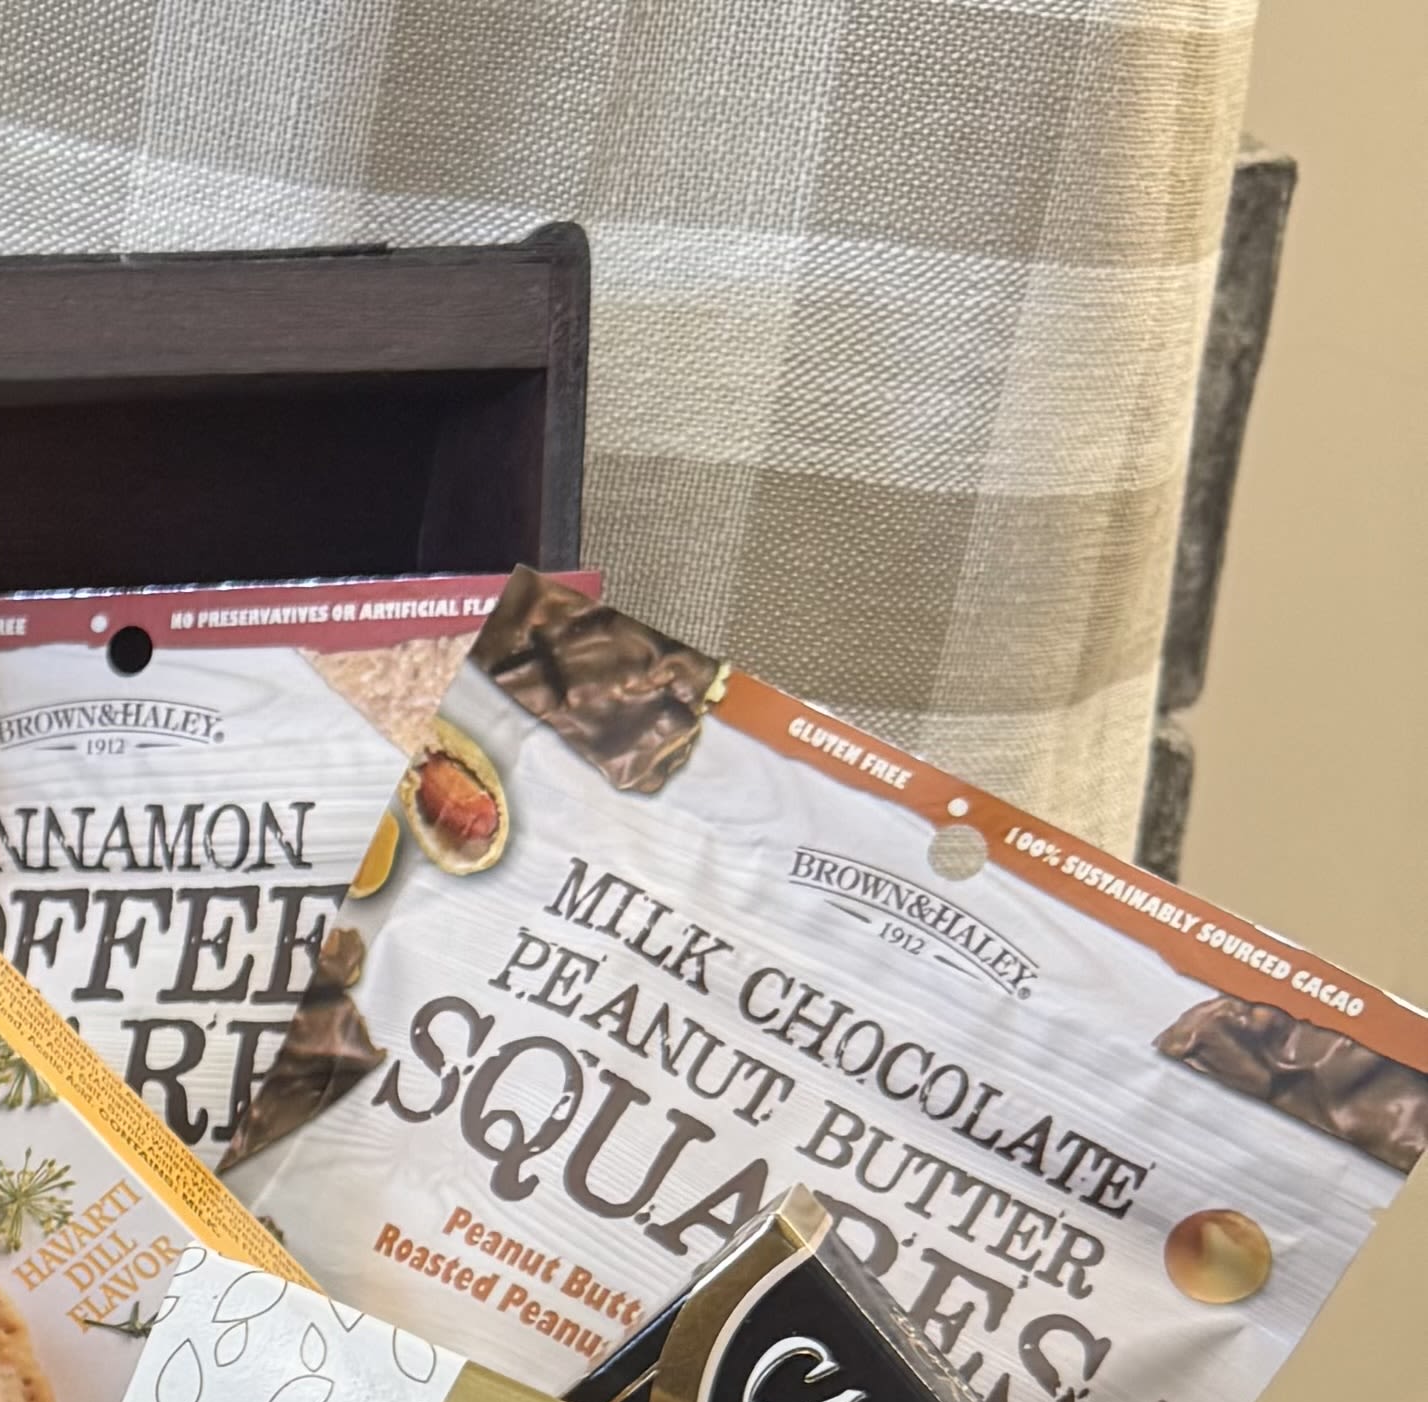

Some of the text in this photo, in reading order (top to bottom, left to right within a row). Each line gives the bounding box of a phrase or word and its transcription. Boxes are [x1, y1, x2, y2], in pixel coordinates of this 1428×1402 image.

[170, 611, 197, 630] NO
[200, 604, 330, 629] PRESERVATIVES
[332, 604, 357, 622] OR
[359, 598, 459, 622] ARTIFICIAL
[85, 738, 127, 757] 1912
[788, 717, 913, 790] GLUTEN FREE
[878, 920, 926, 957] 1912
[1004, 825, 1366, 1019] 100% SUSTAINABLY SOURCED CACAO
[545, 856, 1155, 1221] MILK CHOCOLATE
[489, 926, 791, 1126] PEANUT
[797, 1098, 1107, 1300] BUTTER
[12, 1179, 142, 1292] HAVARTI
[63, 1230, 138, 1294] DILL
[373, 1222, 500, 1304] Roasted
[441, 1206, 642, 1327] Peanut Butt
[65, 1235, 186, 1335] FLAVOR
